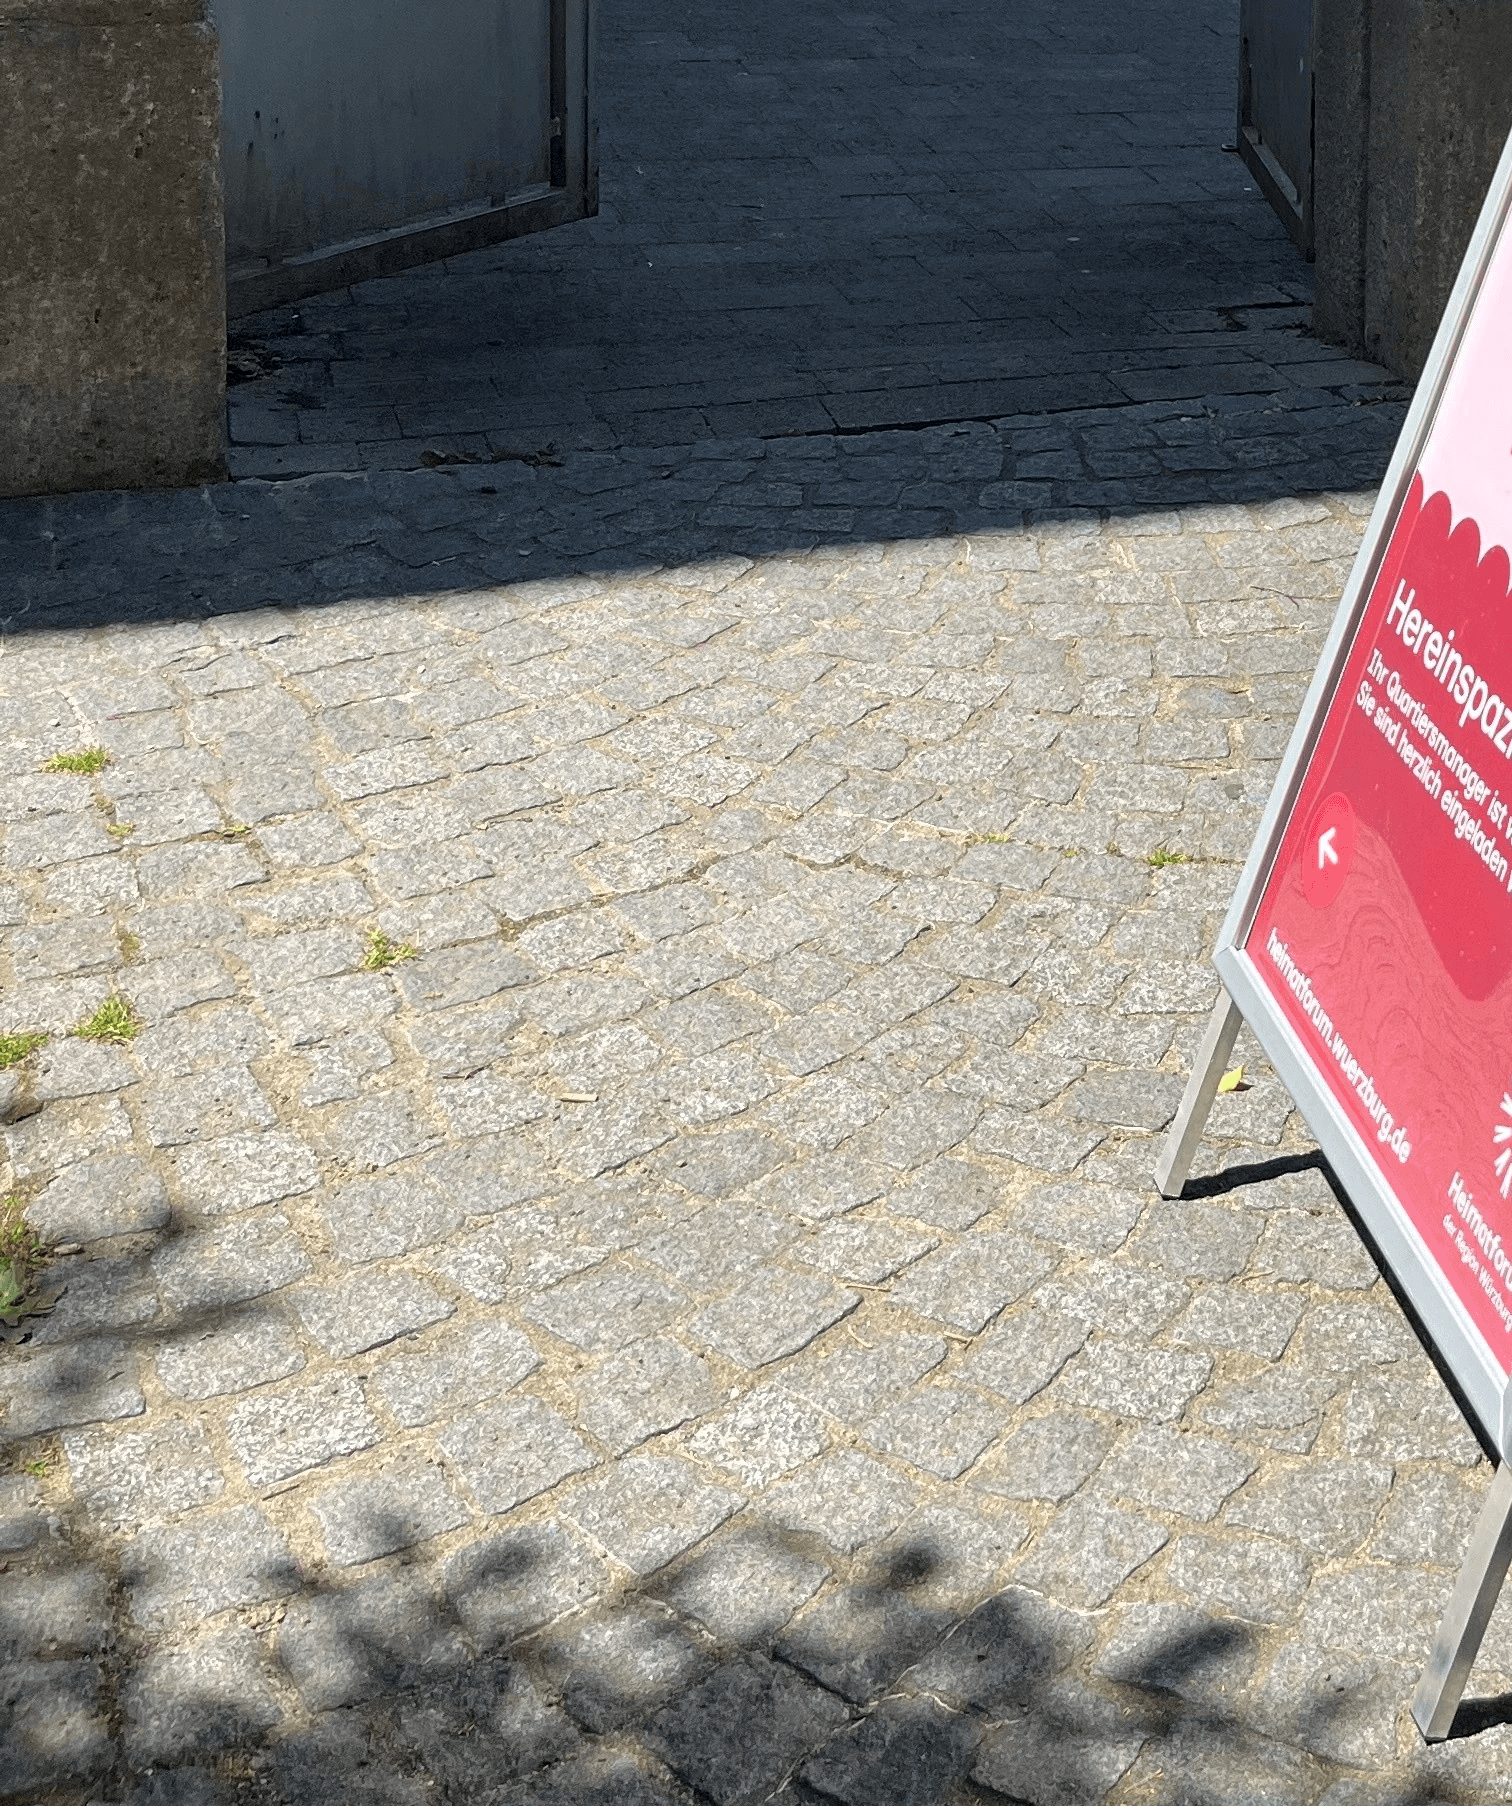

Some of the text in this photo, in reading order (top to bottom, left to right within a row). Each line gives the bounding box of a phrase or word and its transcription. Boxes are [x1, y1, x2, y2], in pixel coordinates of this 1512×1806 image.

[1356, 680, 1377, 717] Sie
[1373, 705, 1402, 747] sind
[1396, 728, 1443, 800] herzlich
[1440, 789, 1509, 882] eingeladen
[1366, 648, 1389, 685] Ihr
[1386, 671, 1492, 806] Quartiersmanager
[1486, 790, 1508, 831] ist
[1266, 926, 1412, 1164] heimatforum.wuerzburg.de
